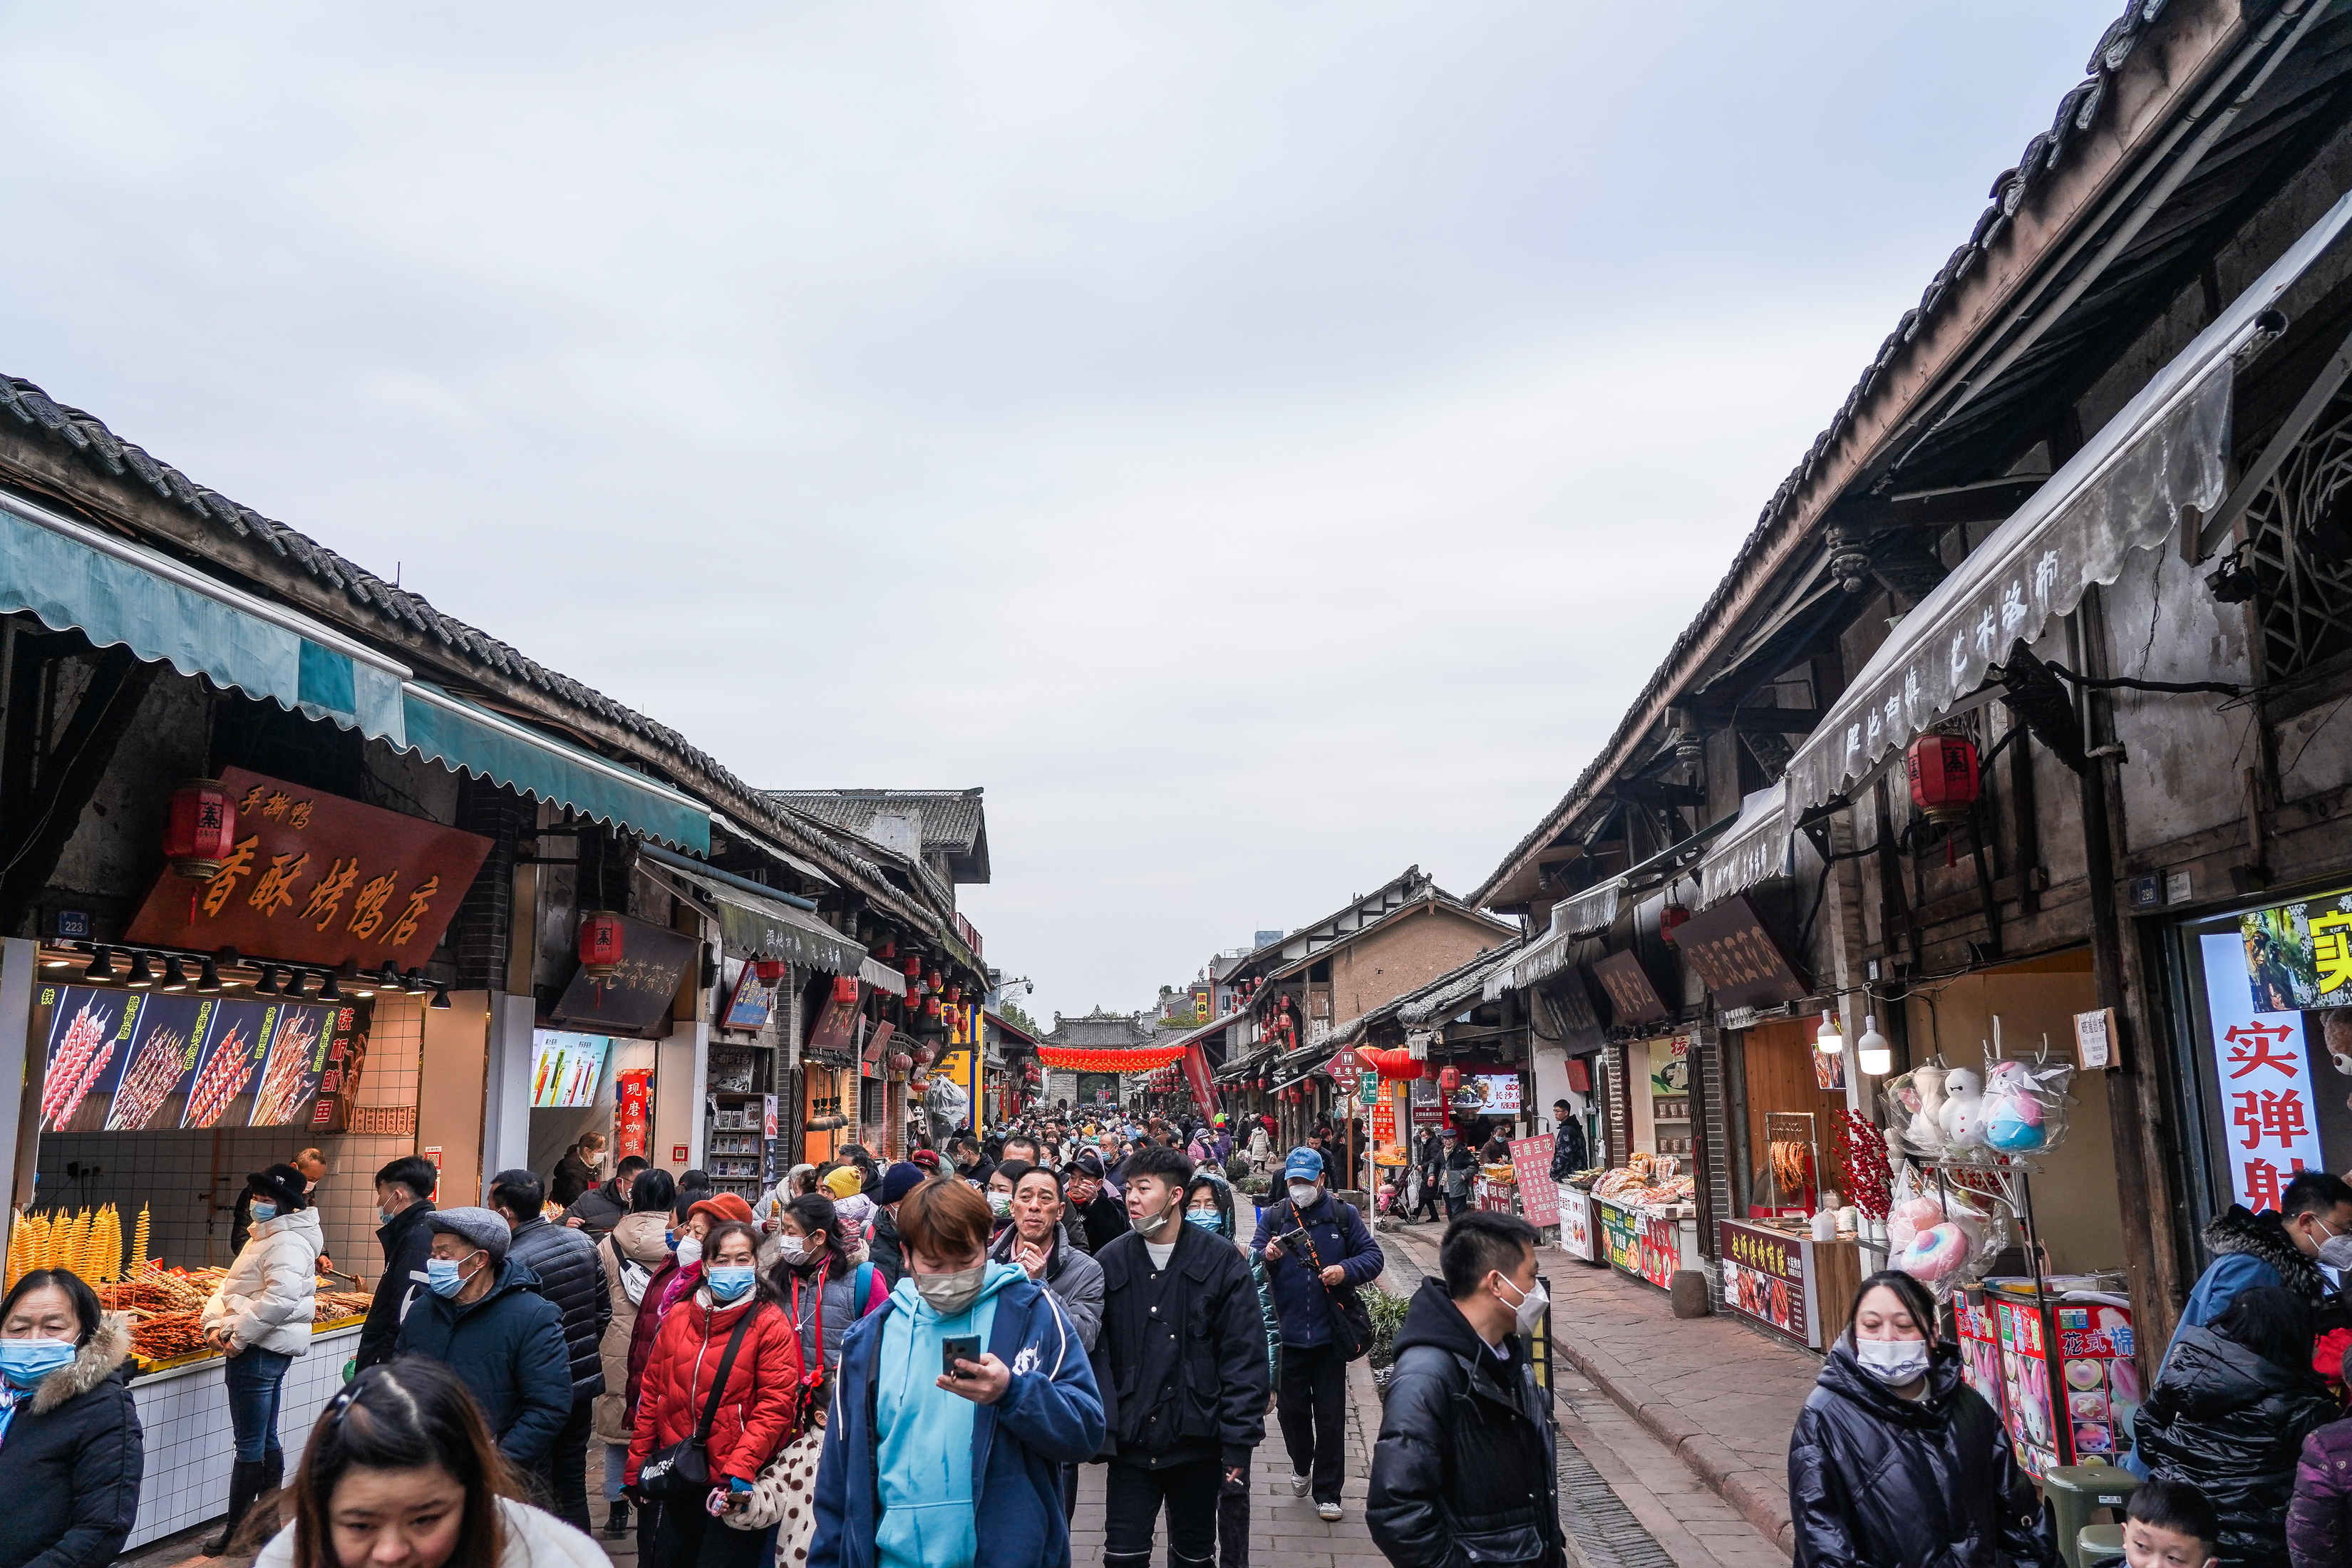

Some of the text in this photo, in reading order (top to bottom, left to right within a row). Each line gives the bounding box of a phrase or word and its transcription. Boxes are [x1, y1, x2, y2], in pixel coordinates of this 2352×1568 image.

[239, 785, 314, 830] 手撕鸭
[202, 835, 438, 947] 香酥烤鸭店
[2142, 888, 2154, 901] 298
[66, 922, 83, 932] 223
[41, 989, 55, 1005] 铁
[118, 996, 140, 1040] 脆骨肠
[254, 1006, 277, 1059] 孜然面筋
[183, 1001, 212, 1071] 香辣烤肉串
[312, 1010, 336, 1073] 火爆鱿鱼须
[313, 1007, 355, 1123] 铁板鱿鱼
[1334, 1066, 1363, 1075] 卫生间
[624, 1082, 642, 1153] 现磨咖啡
[1512, 1138, 1552, 1158] 石磨豆花
[1523, 1158, 1549, 1170] 酸菜豆花
[1517, 1167, 1533, 1220] 老少皆宜
[1530, 1183, 1556, 1195] 牛肉豆花
[1535, 1212, 1552, 1221] 豆花
[1612, 1231, 1626, 1251] 厂价直销
[1613, 1247, 1626, 1267] 免费品尝
[1957, 1310, 1993, 1339] 花式棉花糖
[2012, 1305, 2042, 1353] 棉花糖
[2061, 1324, 2135, 1356] 花式棉
